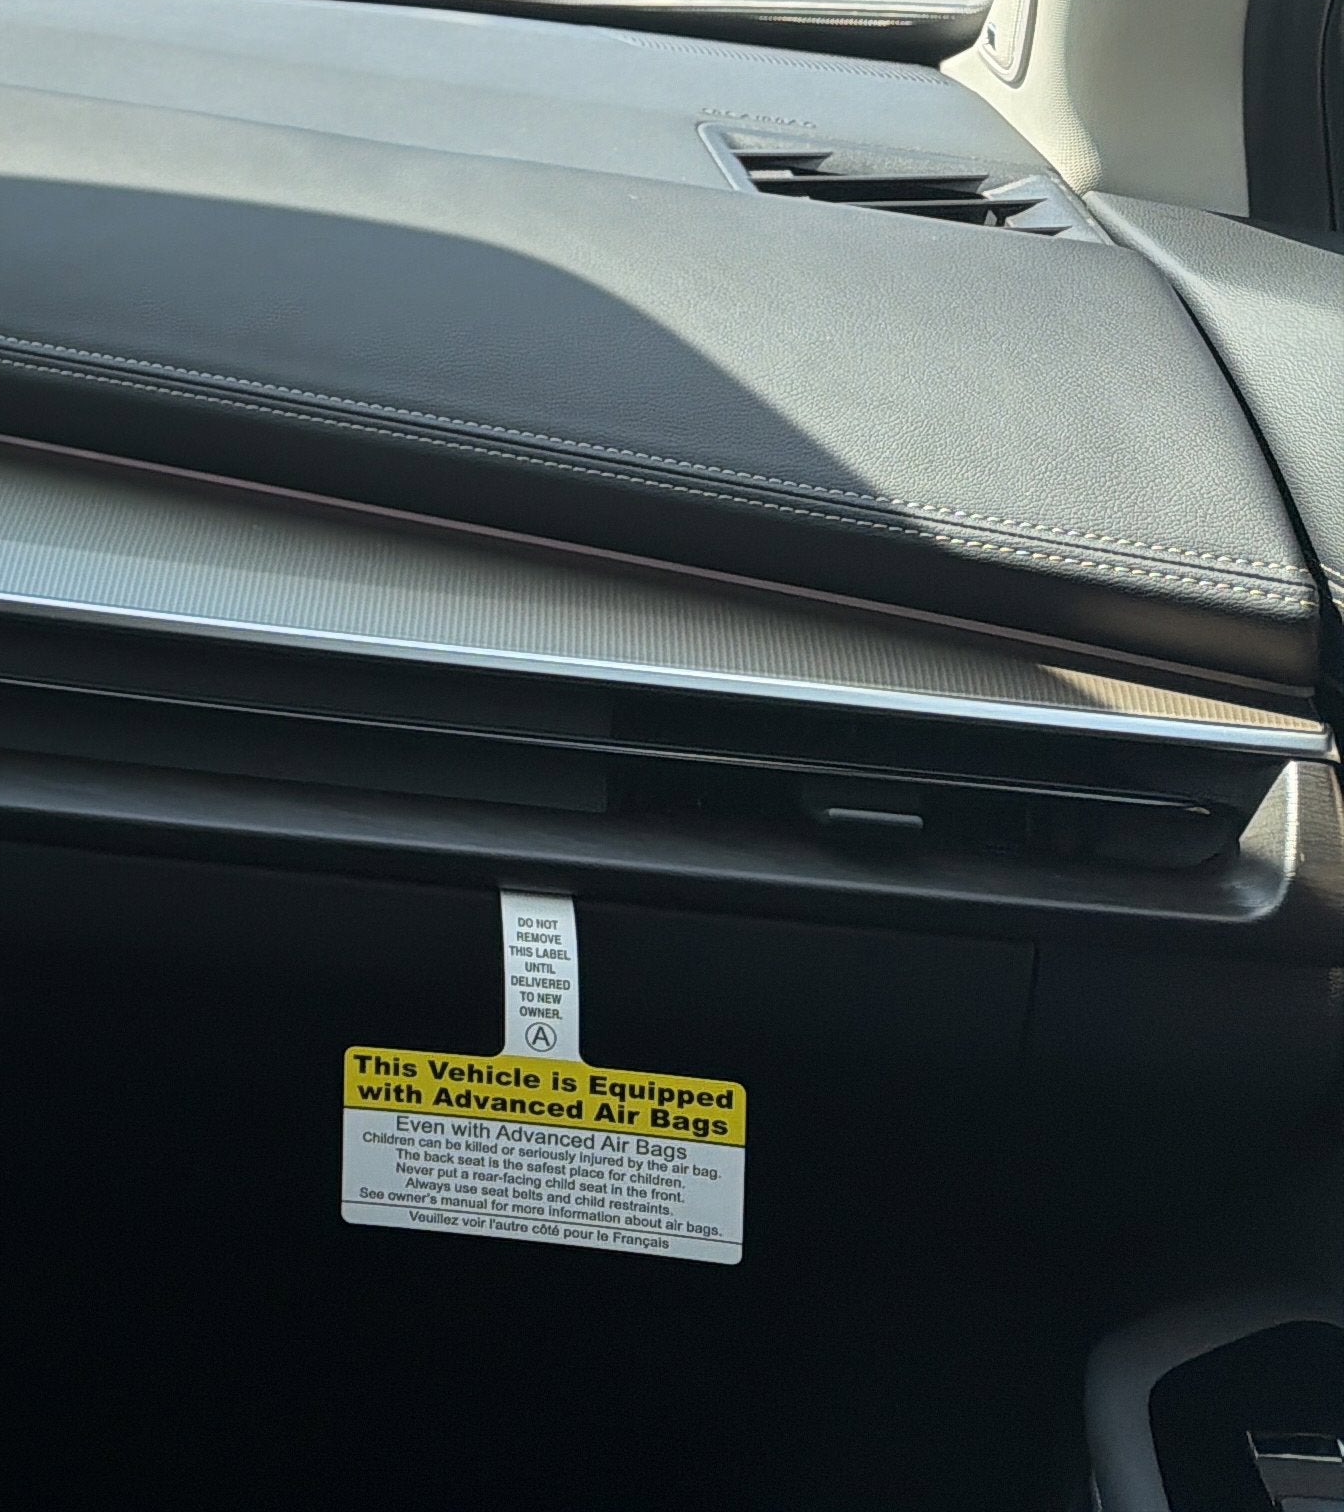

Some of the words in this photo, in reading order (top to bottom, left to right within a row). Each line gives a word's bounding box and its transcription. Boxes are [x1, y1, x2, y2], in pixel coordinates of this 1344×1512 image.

[516, 931, 562, 945] REMOVE
[517, 917, 534, 929] DO
[536, 919, 558, 930] NOT
[509, 945, 534, 958] THIS
[535, 948, 571, 961] LABEL
[525, 962, 556, 974] UNTIL
[510, 975, 571, 991] DELIVERED
[519, 991, 534, 1003] TO
[536, 993, 562, 1004] NEW
[519, 1006, 563, 1020] OWNER.
[353, 1054, 418, 1078] This
[427, 1059, 541, 1089] Vehicle
[551, 1071, 578, 1093] is
[589, 1074, 734, 1110] Equipped
[357, 1082, 422, 1105] with
[432, 1087, 584, 1120] Advanced
[593, 1102, 641, 1125] Air
[650, 1107, 729, 1138] Bags
[362, 1131, 415, 1147] Children
[418, 1138, 442, 1150] can
[445, 1137, 462, 1151] be
[464, 1139, 498, 1155] killed
[501, 1146, 516, 1156] or
[518, 1147, 577, 1165] seriously
[578, 1151, 624, 1171] injured
[627, 1156, 644, 1172] by
[647, 1159, 671, 1173] the
[671, 1162, 690, 1175] air
[692, 1163, 722, 1181] bag.
[396, 1114, 445, 1136] Even
[451, 1121, 491, 1140] with
[495, 1124, 595, 1150] Advanced
[600, 1135, 630, 1154] Air
[635, 1138, 688, 1163] Bags
[395, 1147, 421, 1162] The
[423, 1150, 455, 1165] back
[457, 1155, 486, 1168] seat
[488, 1156, 500, 1169] is
[502, 1158, 524, 1171] the
[526, 1161, 566, 1176] safest
[569, 1165, 605, 1180] place
[608, 1169, 627, 1182] for
[629, 1172, 686, 1190] children.
[395, 1161, 435, 1177] Never
[437, 1167, 458, 1179] put
[460, 1170, 470, 1180] a
[472, 1171, 542, 1190] rear-facing
[545, 1177, 576, 1191] child
[578, 1182, 608, 1195] seat
[610, 1183, 623, 1197] in
[626, 1185, 648, 1199] the
[651, 1188, 685, 1204] front.
[358, 1186, 385, 1200] See
[387, 1191, 438, 1205] owner's
[440, 1196, 488, 1210] manual
[490, 1199, 509, 1212] for
[511, 1203, 545, 1216] more
[548, 1205, 621, 1225] information
[624, 1214, 663, 1230] about
[665, 1219, 684, 1232] air
[686, 1221, 723, 1238] bags.
[404, 1176, 451, 1194] Always
[454, 1183, 478, 1195] use
[480, 1186, 509, 1198] seat
[512, 1186, 544, 1202] belts
[546, 1193, 572, 1205] and
[574, 1194, 606, 1209] child
[608, 1200, 674, 1216] restraints.
[407, 1207, 459, 1226] Veuillez
[461, 1216, 487, 1229] voir
[489, 1218, 529, 1233] l'autre
[531, 1223, 560, 1237] côté
[563, 1228, 594, 1240] pour
[596, 1229, 609, 1242] le
[612, 1231, 670, 1250] Français
